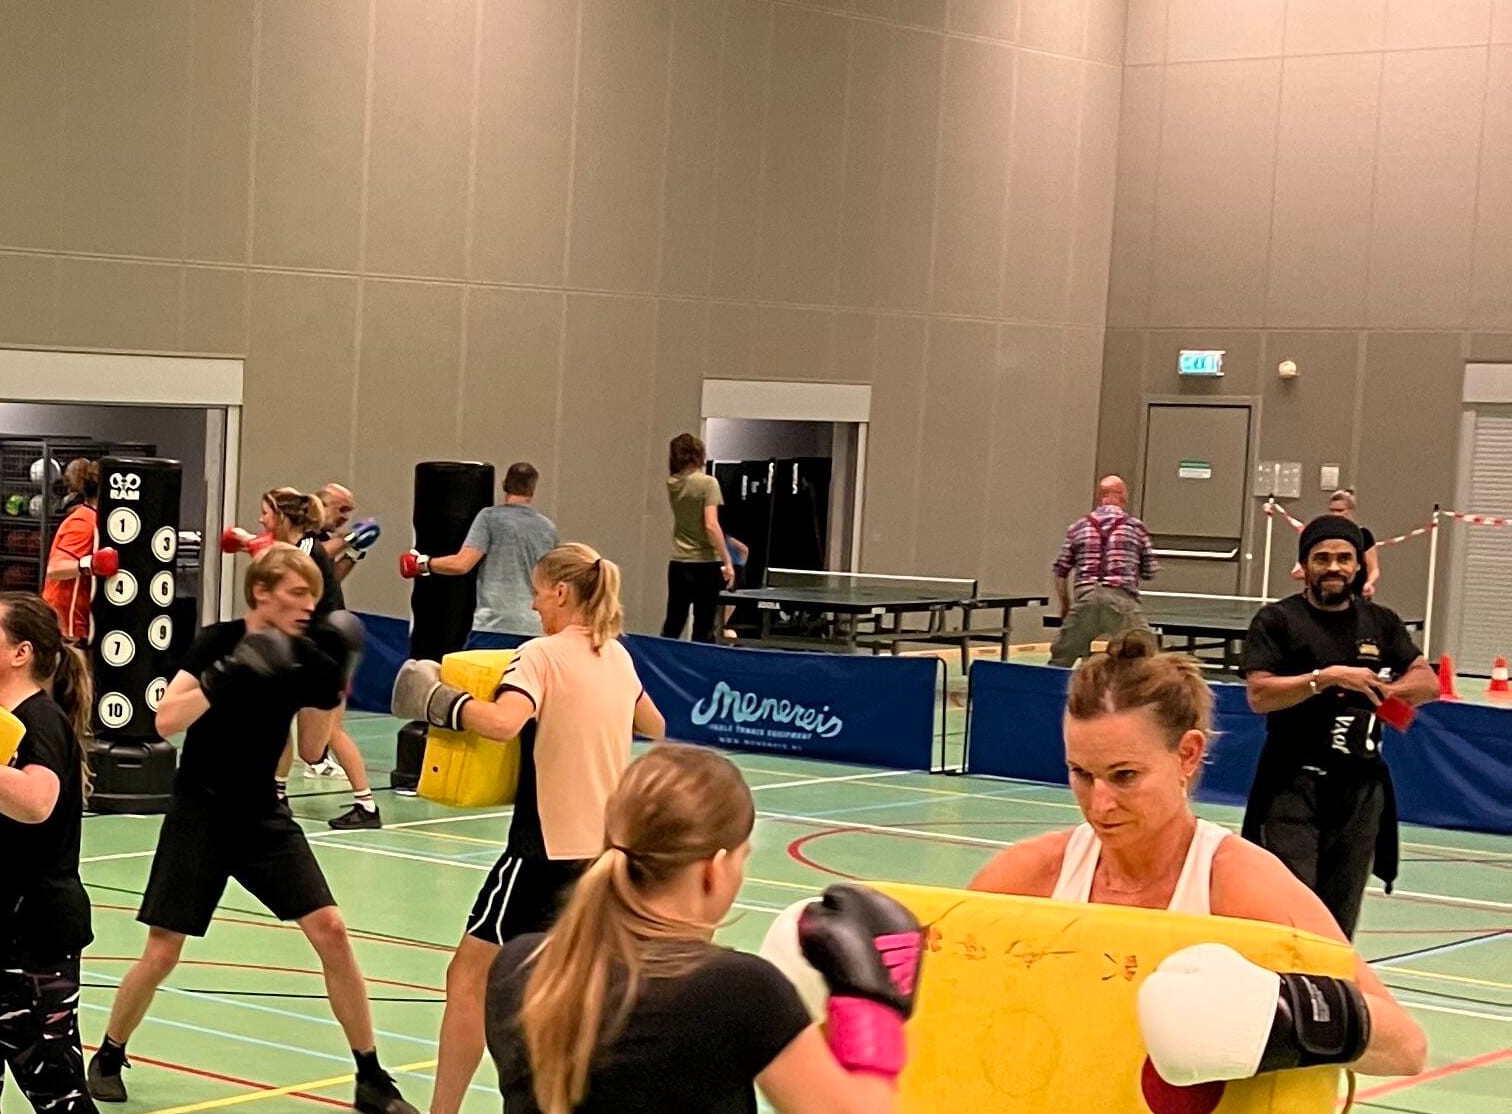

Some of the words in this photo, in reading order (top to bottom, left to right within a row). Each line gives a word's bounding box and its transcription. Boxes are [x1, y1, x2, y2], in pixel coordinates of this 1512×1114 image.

[110, 488, 140, 500] RAM
[119, 518, 126, 533] 1
[163, 536, 171, 552] 3
[115, 580, 124, 595] 4
[161, 581, 170, 596] 6
[159, 625, 167, 640] 9
[114, 641, 121, 656] 7
[108, 703, 123, 718] 10
[1331, 716, 1356, 754] JOYA
